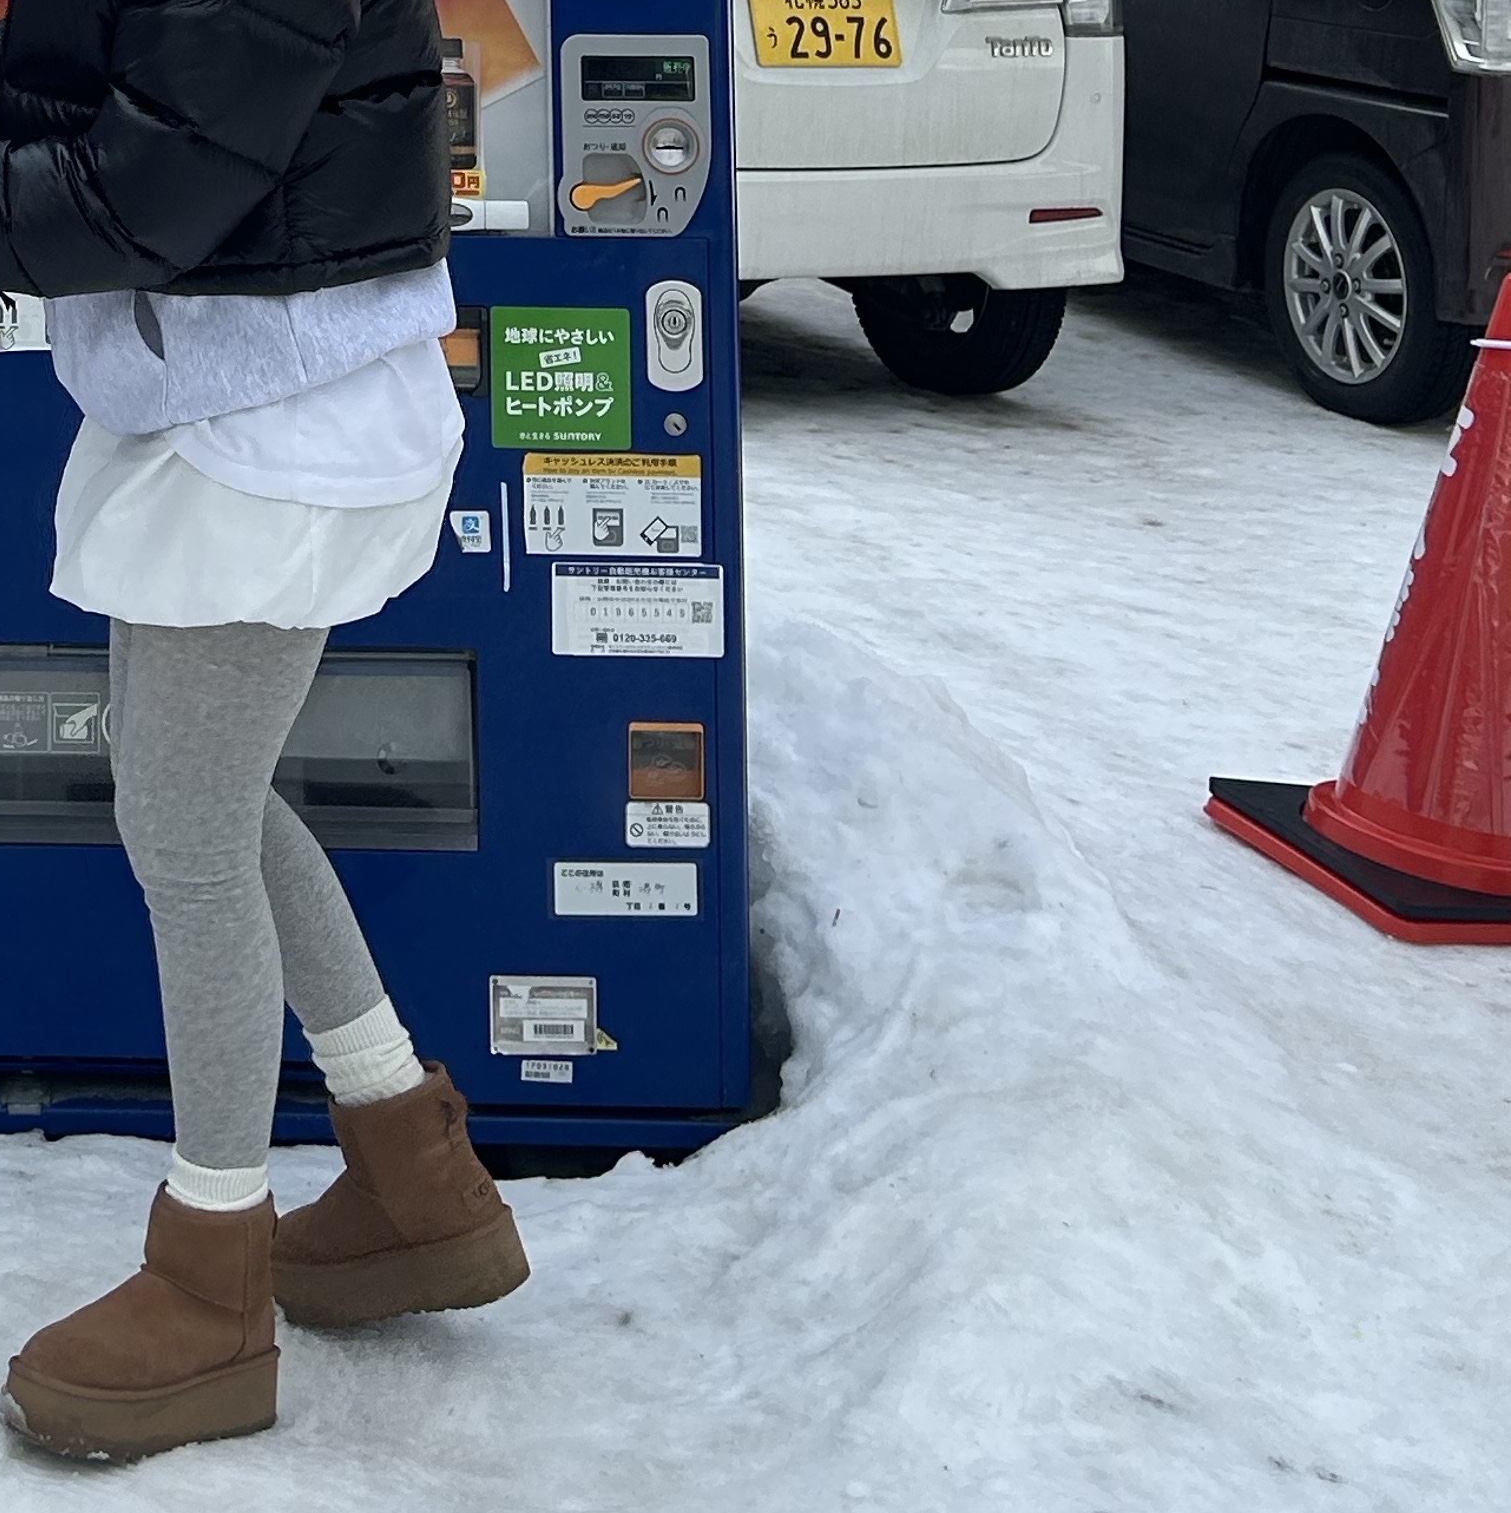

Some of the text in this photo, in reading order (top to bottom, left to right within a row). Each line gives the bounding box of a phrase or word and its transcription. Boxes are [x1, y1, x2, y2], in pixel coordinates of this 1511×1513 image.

[767, 16, 893, 60] う 29-76
[986, 36, 1054, 59] Tanto
[504, 327, 615, 345] 地球にやさしい
[543, 349, 579, 365] 省エネ!
[505, 371, 614, 393] LED照明&
[505, 396, 615, 418] ヒートポンプ
[553, 432, 602, 442] SUNTORY
[560, 869, 605, 878] ここの住所は
